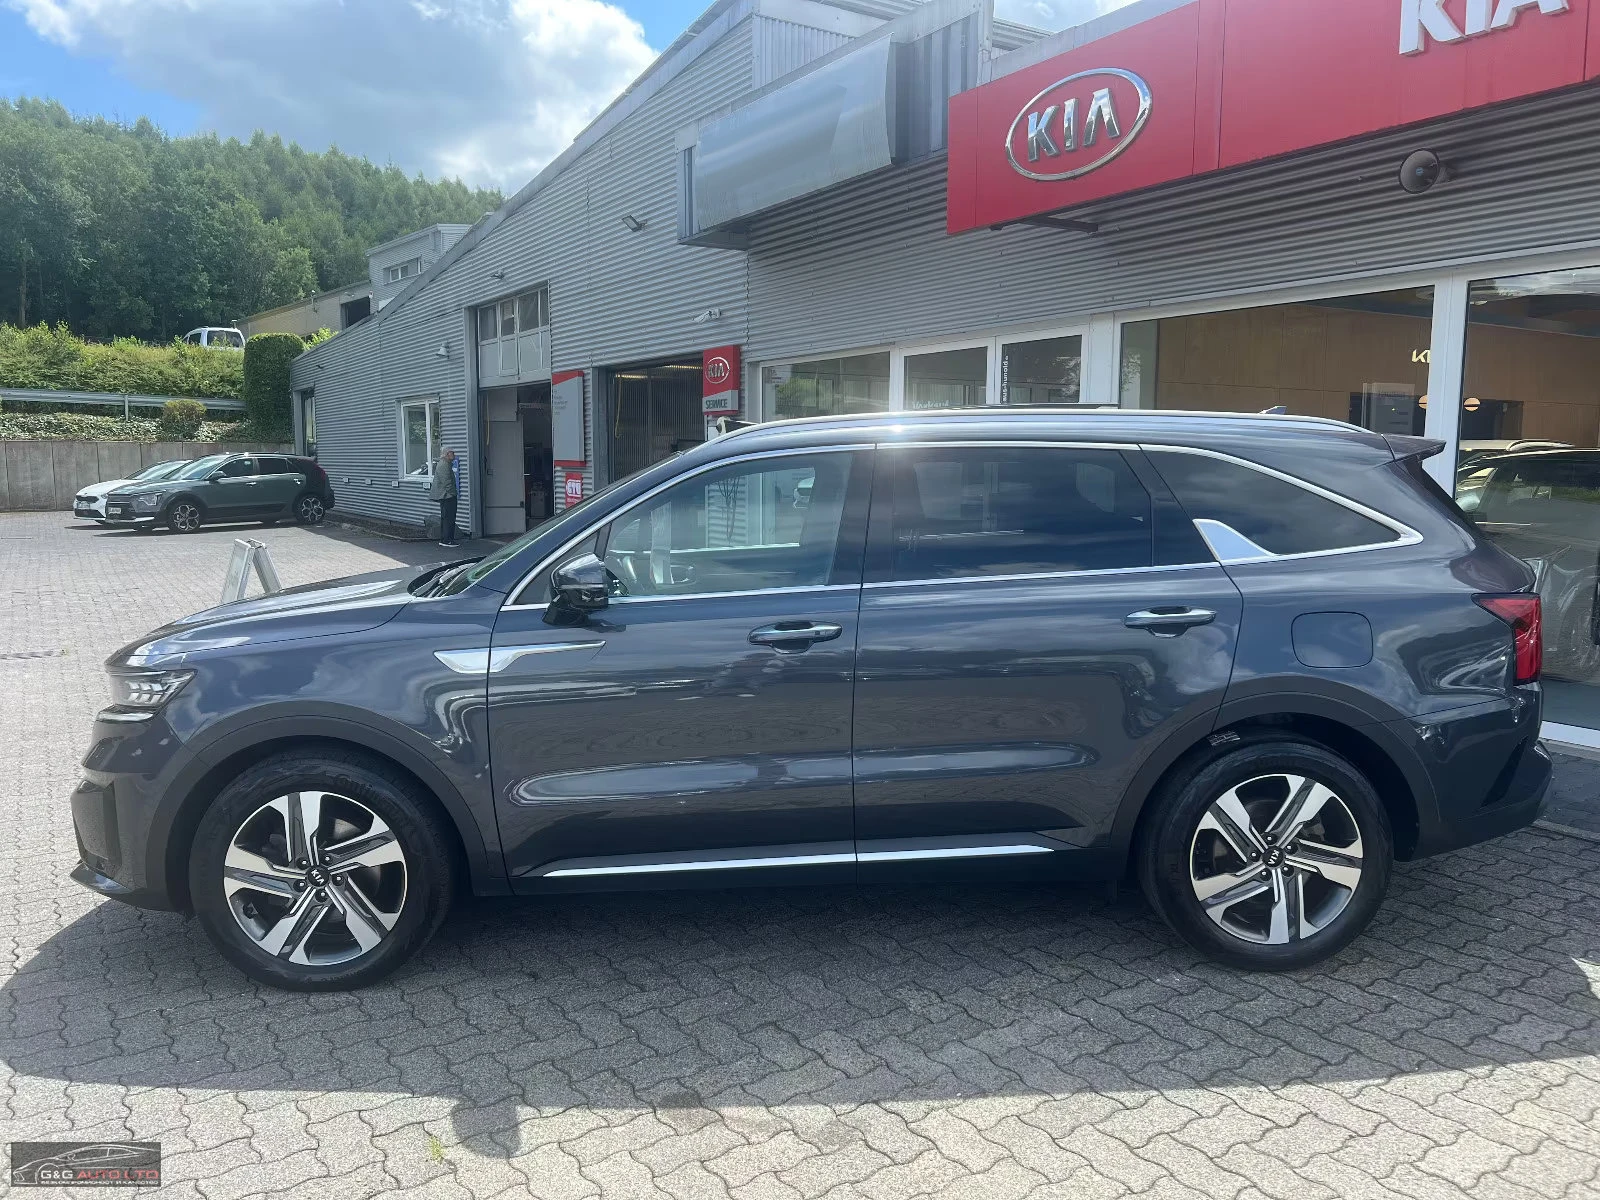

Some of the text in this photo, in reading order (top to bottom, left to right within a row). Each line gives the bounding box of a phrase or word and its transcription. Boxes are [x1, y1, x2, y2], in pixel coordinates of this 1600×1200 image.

[1027, 87, 1120, 162] KIA
[708, 362, 725, 378] KIA
[705, 399, 728, 409] SERVICE
[1268, 850, 1279, 864] KIA
[311, 869, 324, 884] KIA
